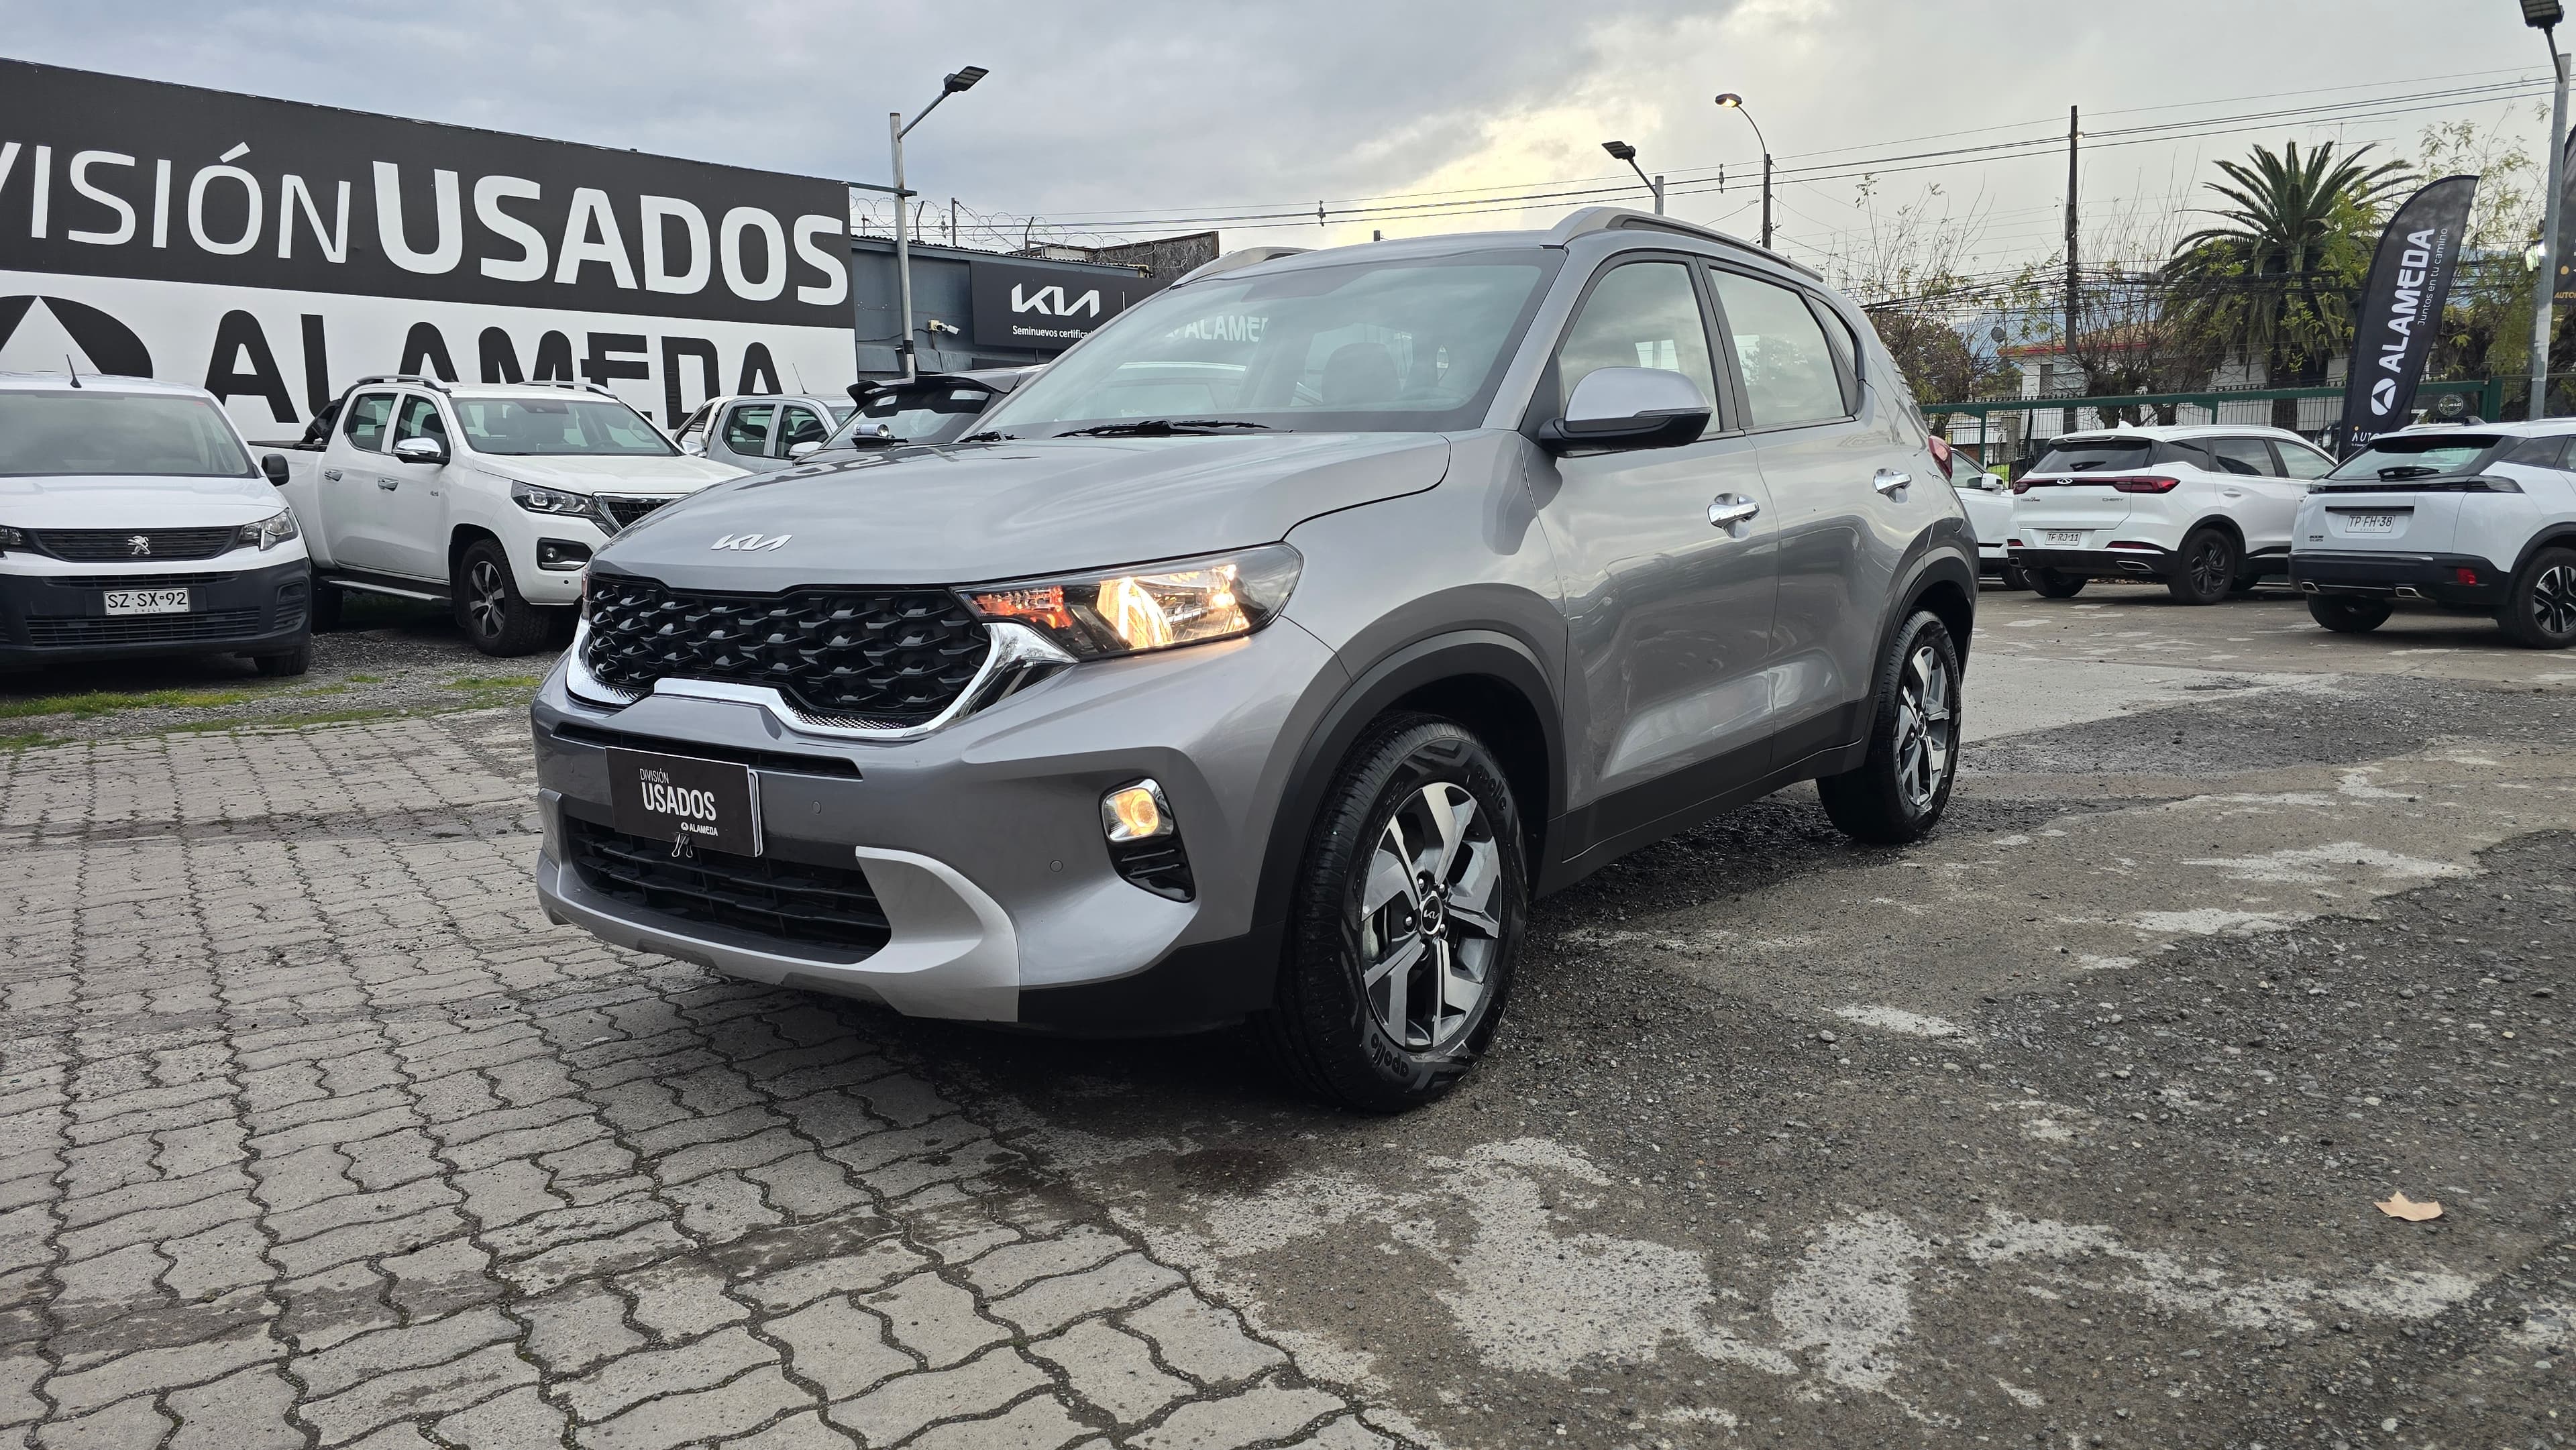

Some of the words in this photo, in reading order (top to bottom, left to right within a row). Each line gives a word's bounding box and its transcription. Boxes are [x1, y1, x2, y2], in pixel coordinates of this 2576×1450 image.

[373, 161, 848, 306] USADOS
[2434, 228, 2448, 265] camino
[2428, 280, 2436, 292] en
[2430, 266, 2440, 278] tu
[1012, 283, 1099, 318] KIA
[2379, 229, 2435, 374] ALAMEDA
[2418, 293, 2433, 327] Juntos
[1012, 325, 1058, 337] Seminuevos
[710, 533, 793, 551] KIA
[639, 768, 669, 783] DIVISIÓN
[641, 782, 716, 821] USADOS
[689, 823, 718, 836] ALAMEDA
[1371, 1033, 1409, 1077] apollo
